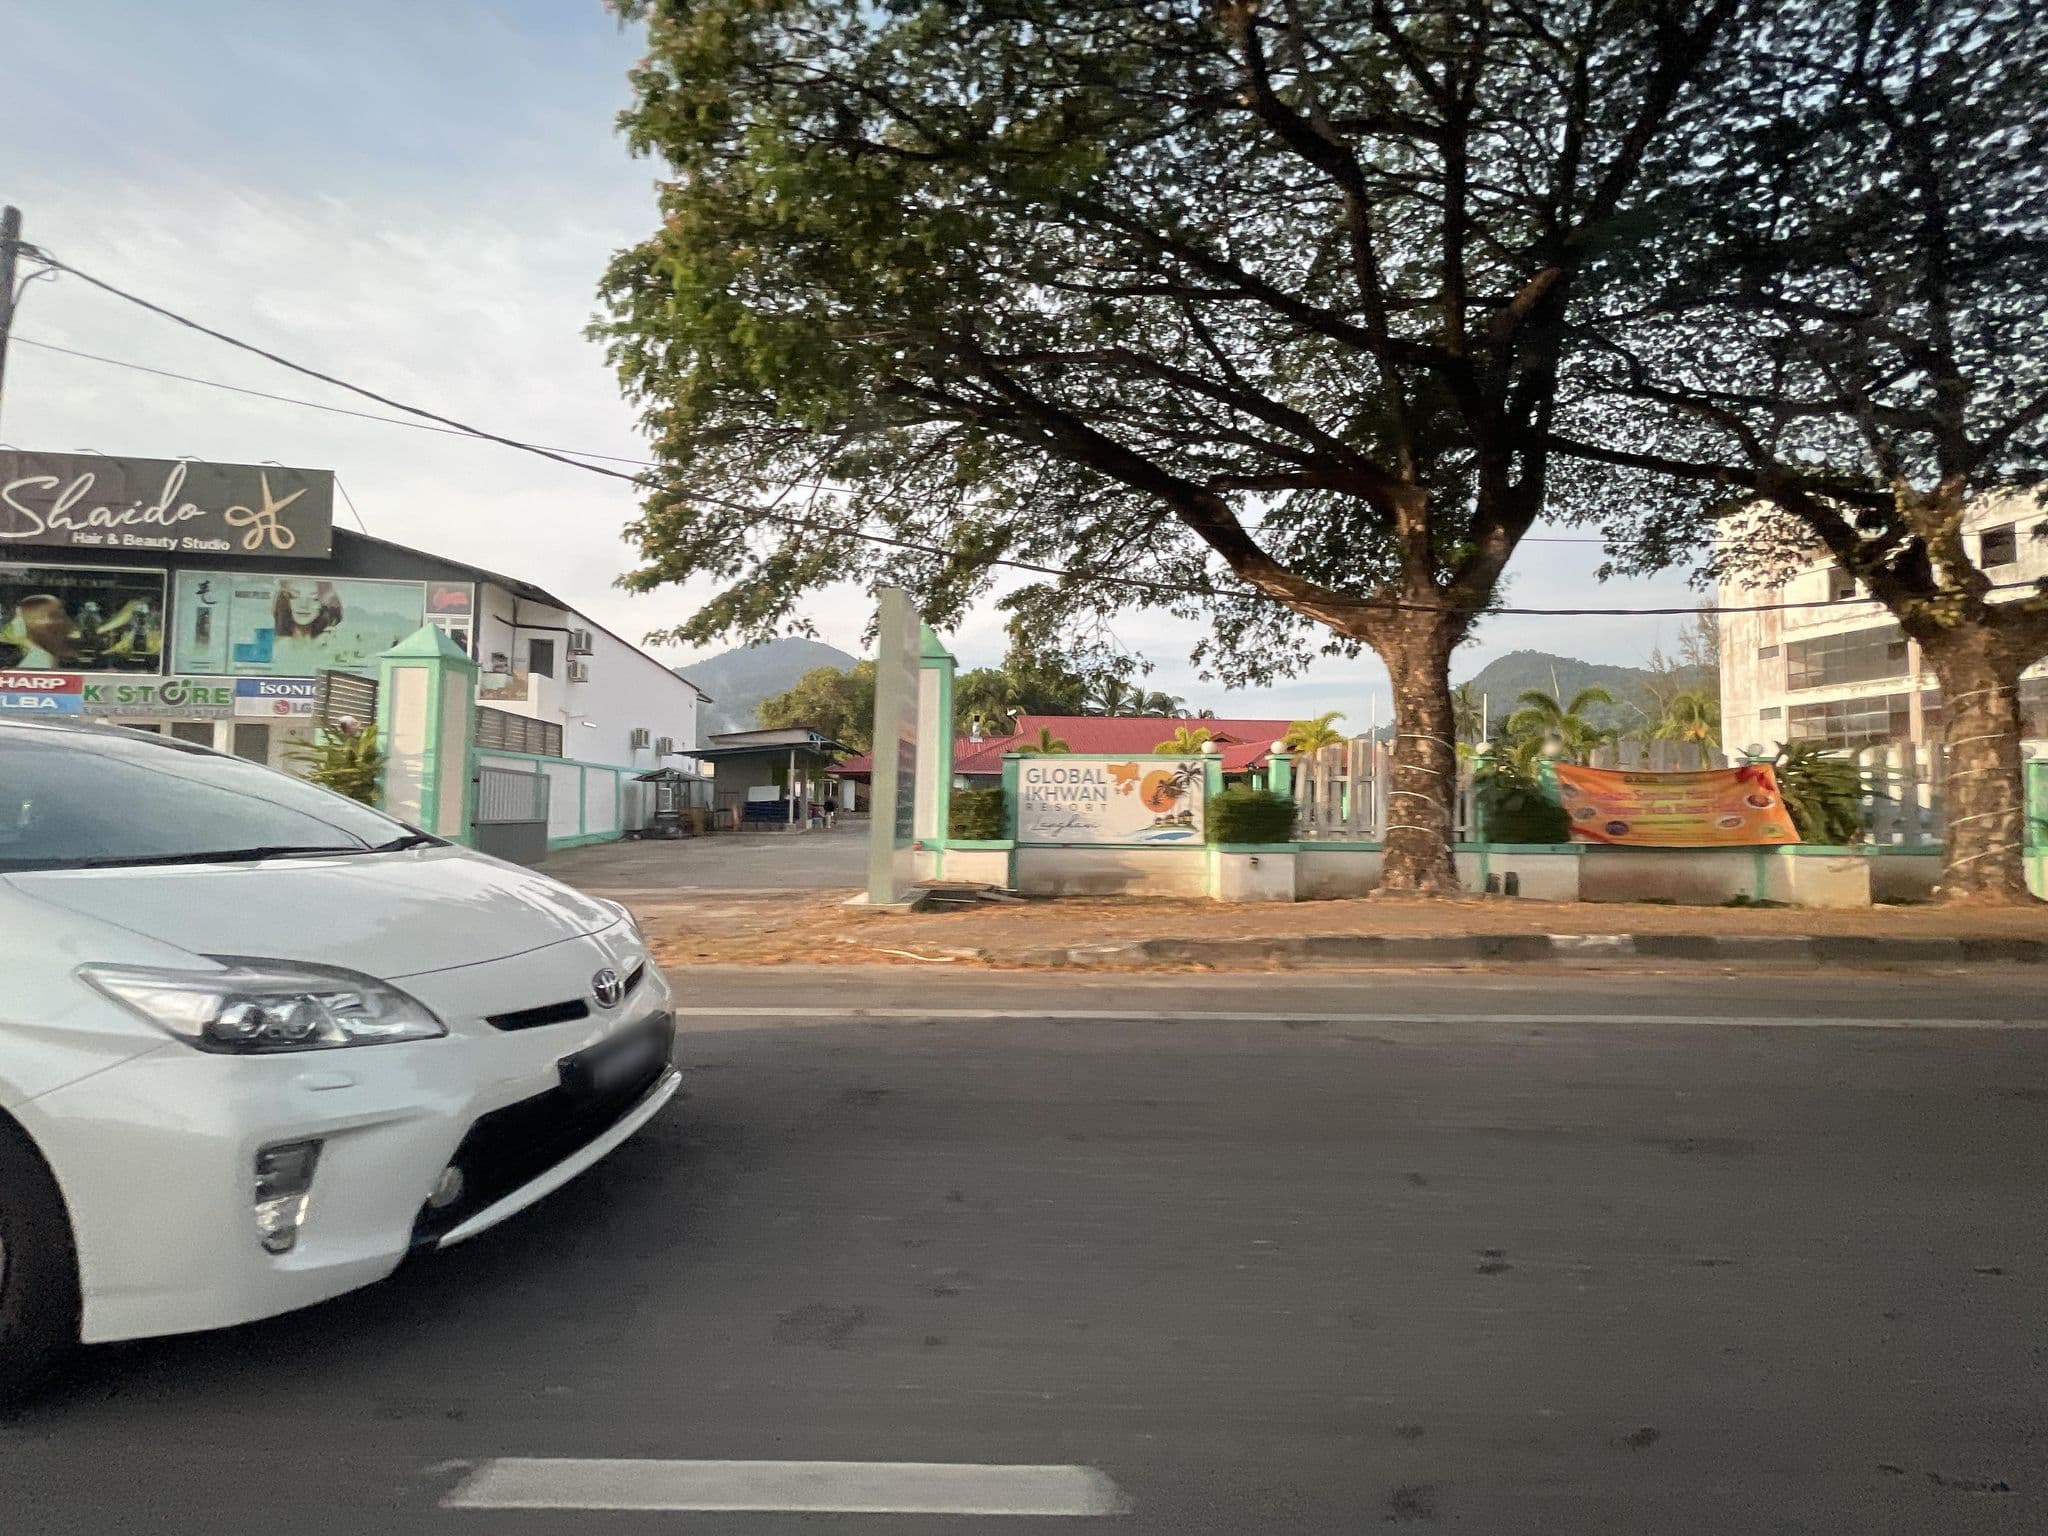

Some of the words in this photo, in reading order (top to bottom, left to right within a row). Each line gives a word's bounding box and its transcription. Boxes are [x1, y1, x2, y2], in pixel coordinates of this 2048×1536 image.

[0, 462, 206, 538] Shaido
[72, 532, 102, 544] Hair
[107, 533, 118, 545] &
[123, 534, 178, 550] Beauty
[182, 537, 231, 551] Studio
[117, 679, 231, 706] STORE
[1026, 768, 1106, 784] GLOBAL
[1025, 786, 1107, 801] IKHWAN
[1025, 803, 1107, 812] RESORT
